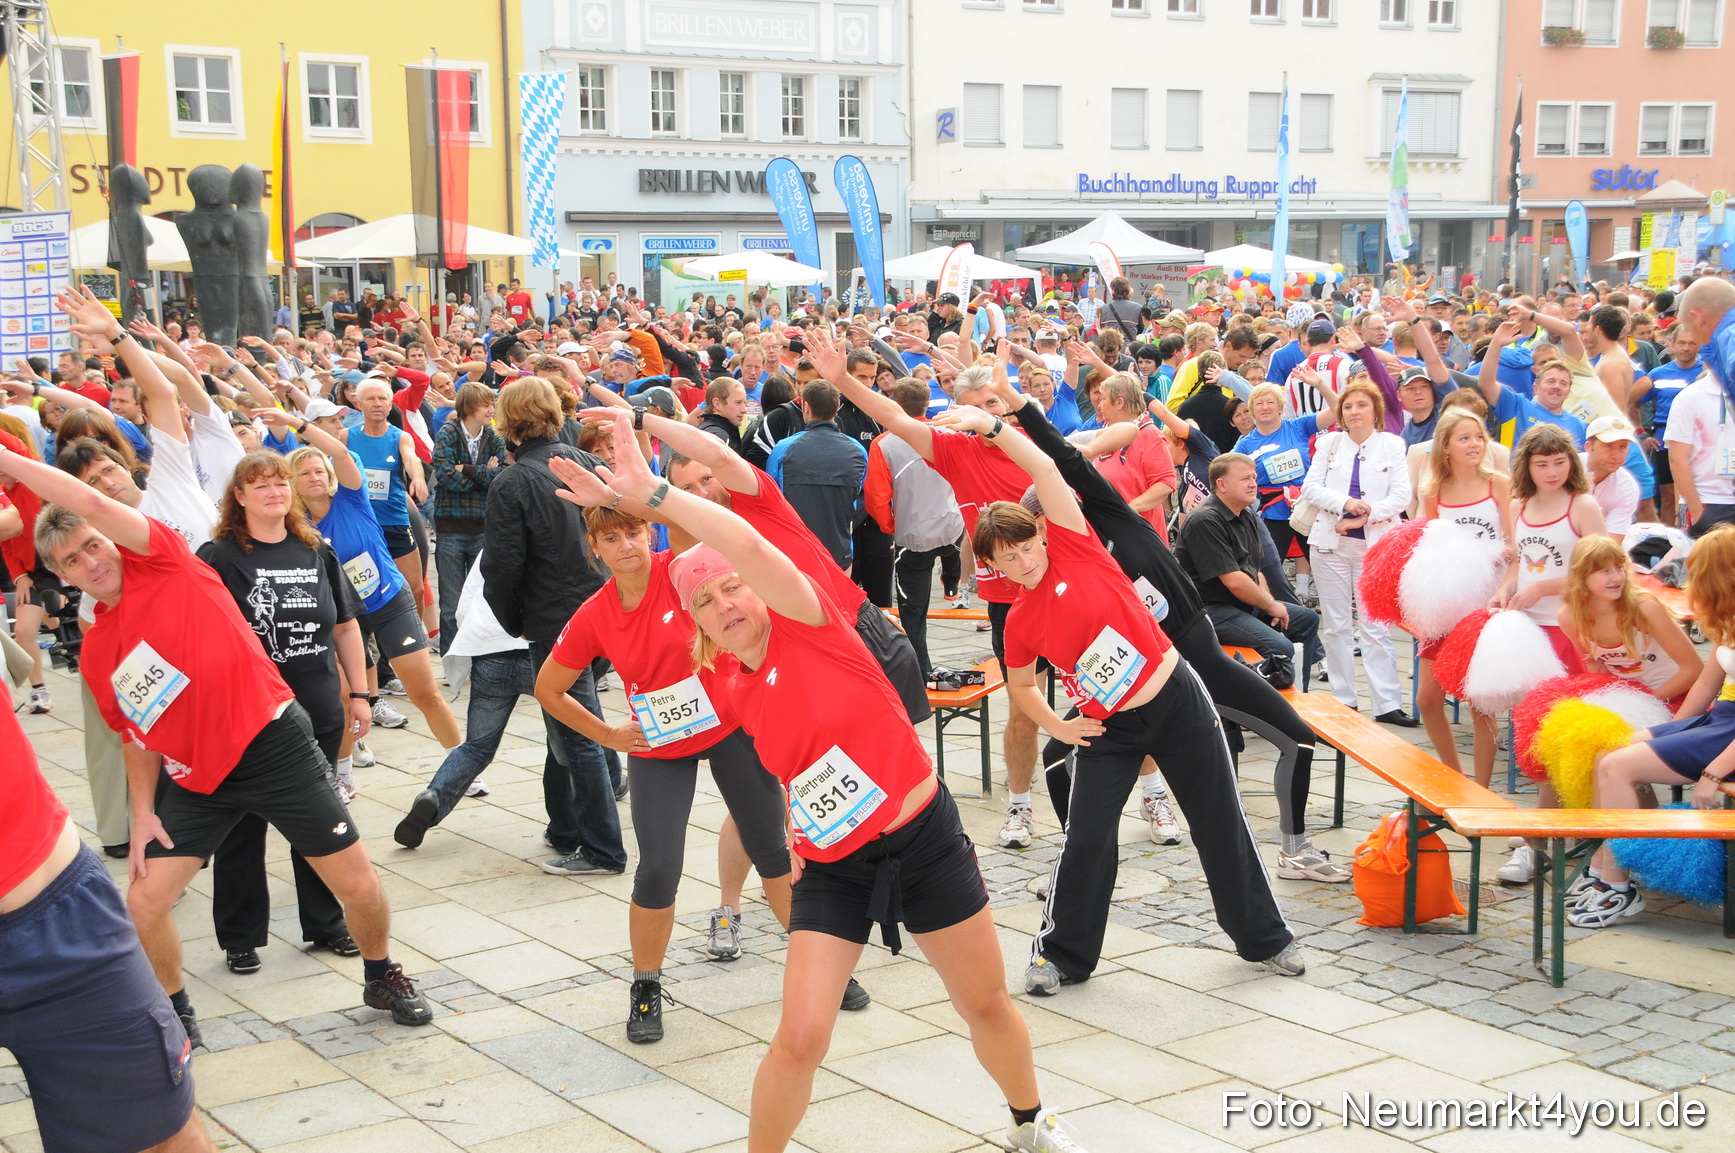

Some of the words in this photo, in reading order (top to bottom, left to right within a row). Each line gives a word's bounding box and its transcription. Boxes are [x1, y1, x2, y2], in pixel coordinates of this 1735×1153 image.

[655, 12, 732, 36] BRILLEN
[735, 16, 805, 41] WEBER
[639, 168, 731, 194] BRILLEN
[1078, 173, 1219, 199] Buchhandlung
[1225, 174, 1318, 199] Rupprcht
[648, 239, 682, 249] BRILLEN
[683, 239, 713, 249] WEBER
[746, 239, 778, 249] BRILLEN
[942, 230, 977, 241] Rupprecht
[1140, 273, 1163, 281] starker
[1277, 459, 1299, 473] 2782
[367, 480, 385, 490] 095
[256, 567, 318, 577] Neumarkter
[352, 568, 375, 585] 452
[1081, 652, 1101, 672] Sonja
[1095, 646, 1129, 684] 3514
[114, 672, 133, 691] Fritz
[129, 664, 165, 704] 3545
[650, 694, 676, 707] Petra
[659, 698, 700, 725] 3557
[794, 762, 836, 798] Gertraud
[810, 774, 859, 819] 3515
[853, 790, 883, 820] PFLEIDERER
